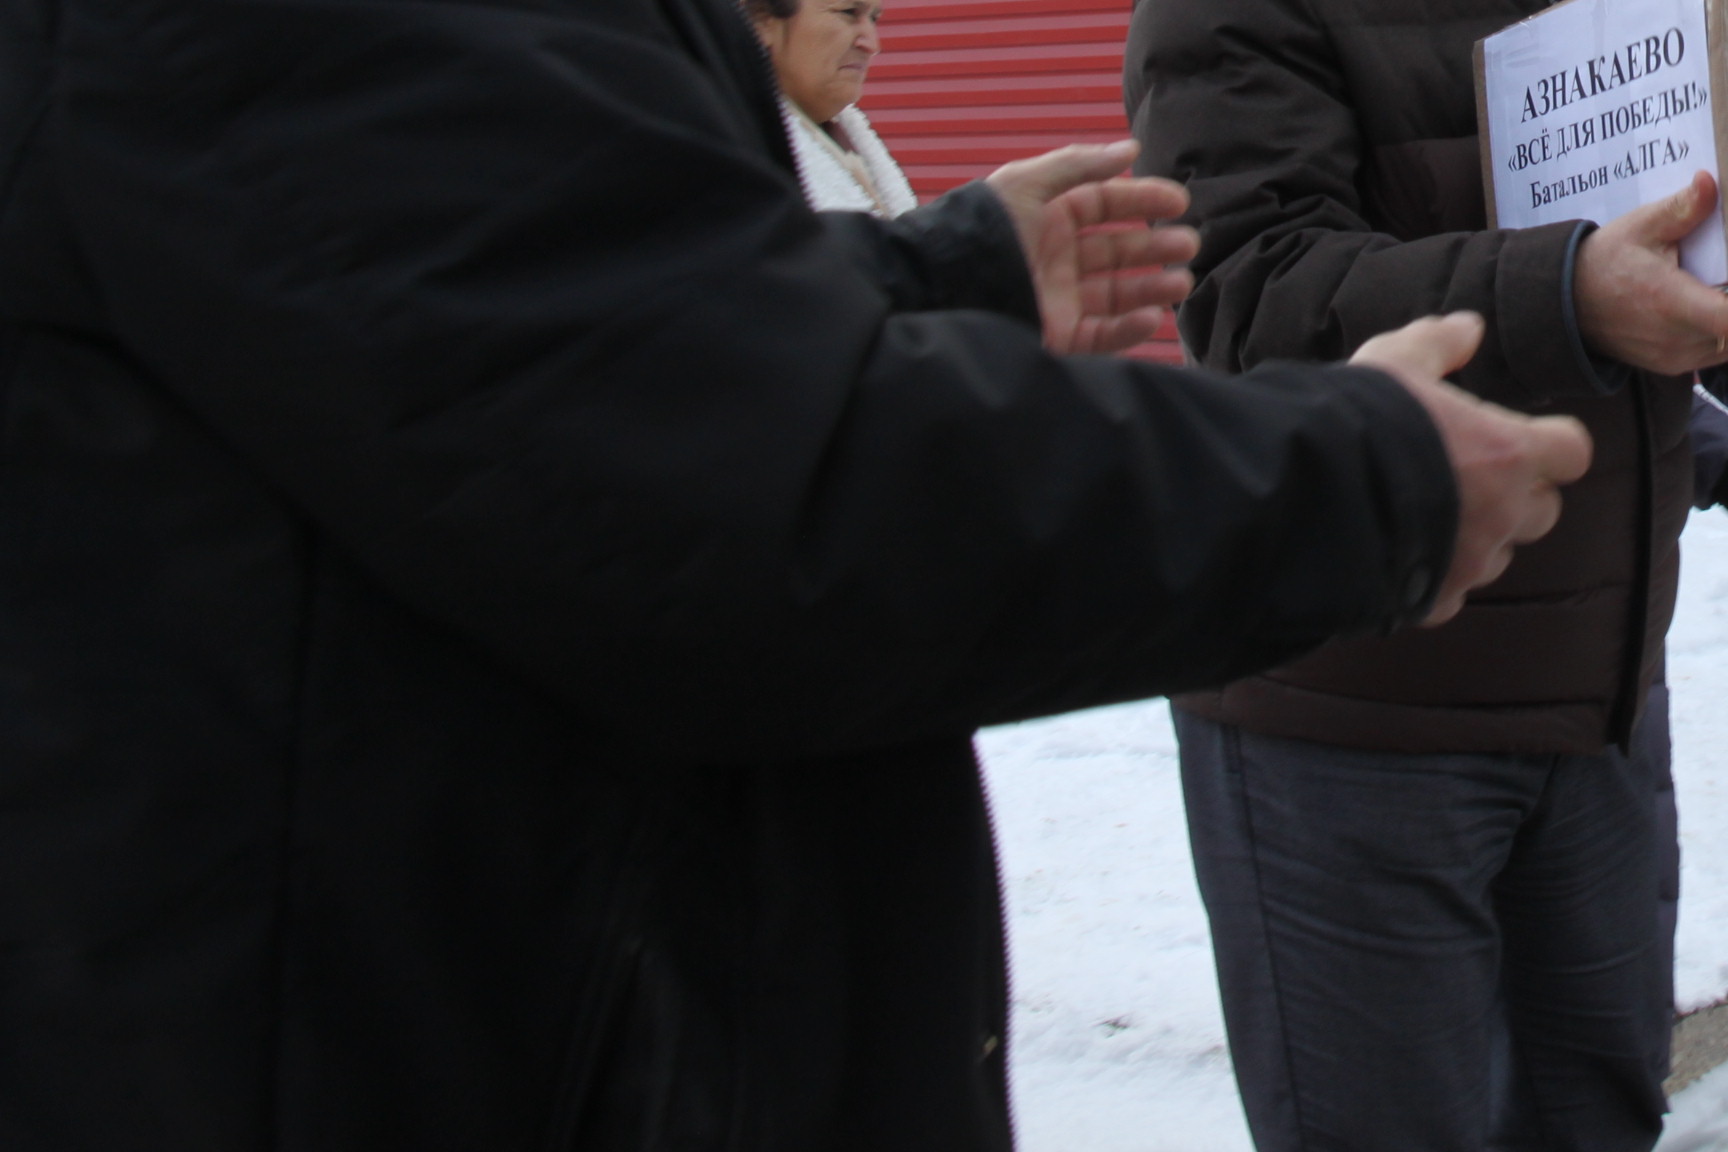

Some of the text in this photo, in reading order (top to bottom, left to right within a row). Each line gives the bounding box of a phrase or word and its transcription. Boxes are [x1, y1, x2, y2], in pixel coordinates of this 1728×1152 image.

[1521, 27, 1685, 123] АЗНАКАЕВО
[1508, 81, 1708, 173] «ВСЁ ДЛЯ ПОБЕДЫ!»
[1530, 136, 1689, 208] Батальон «АЛГА»
